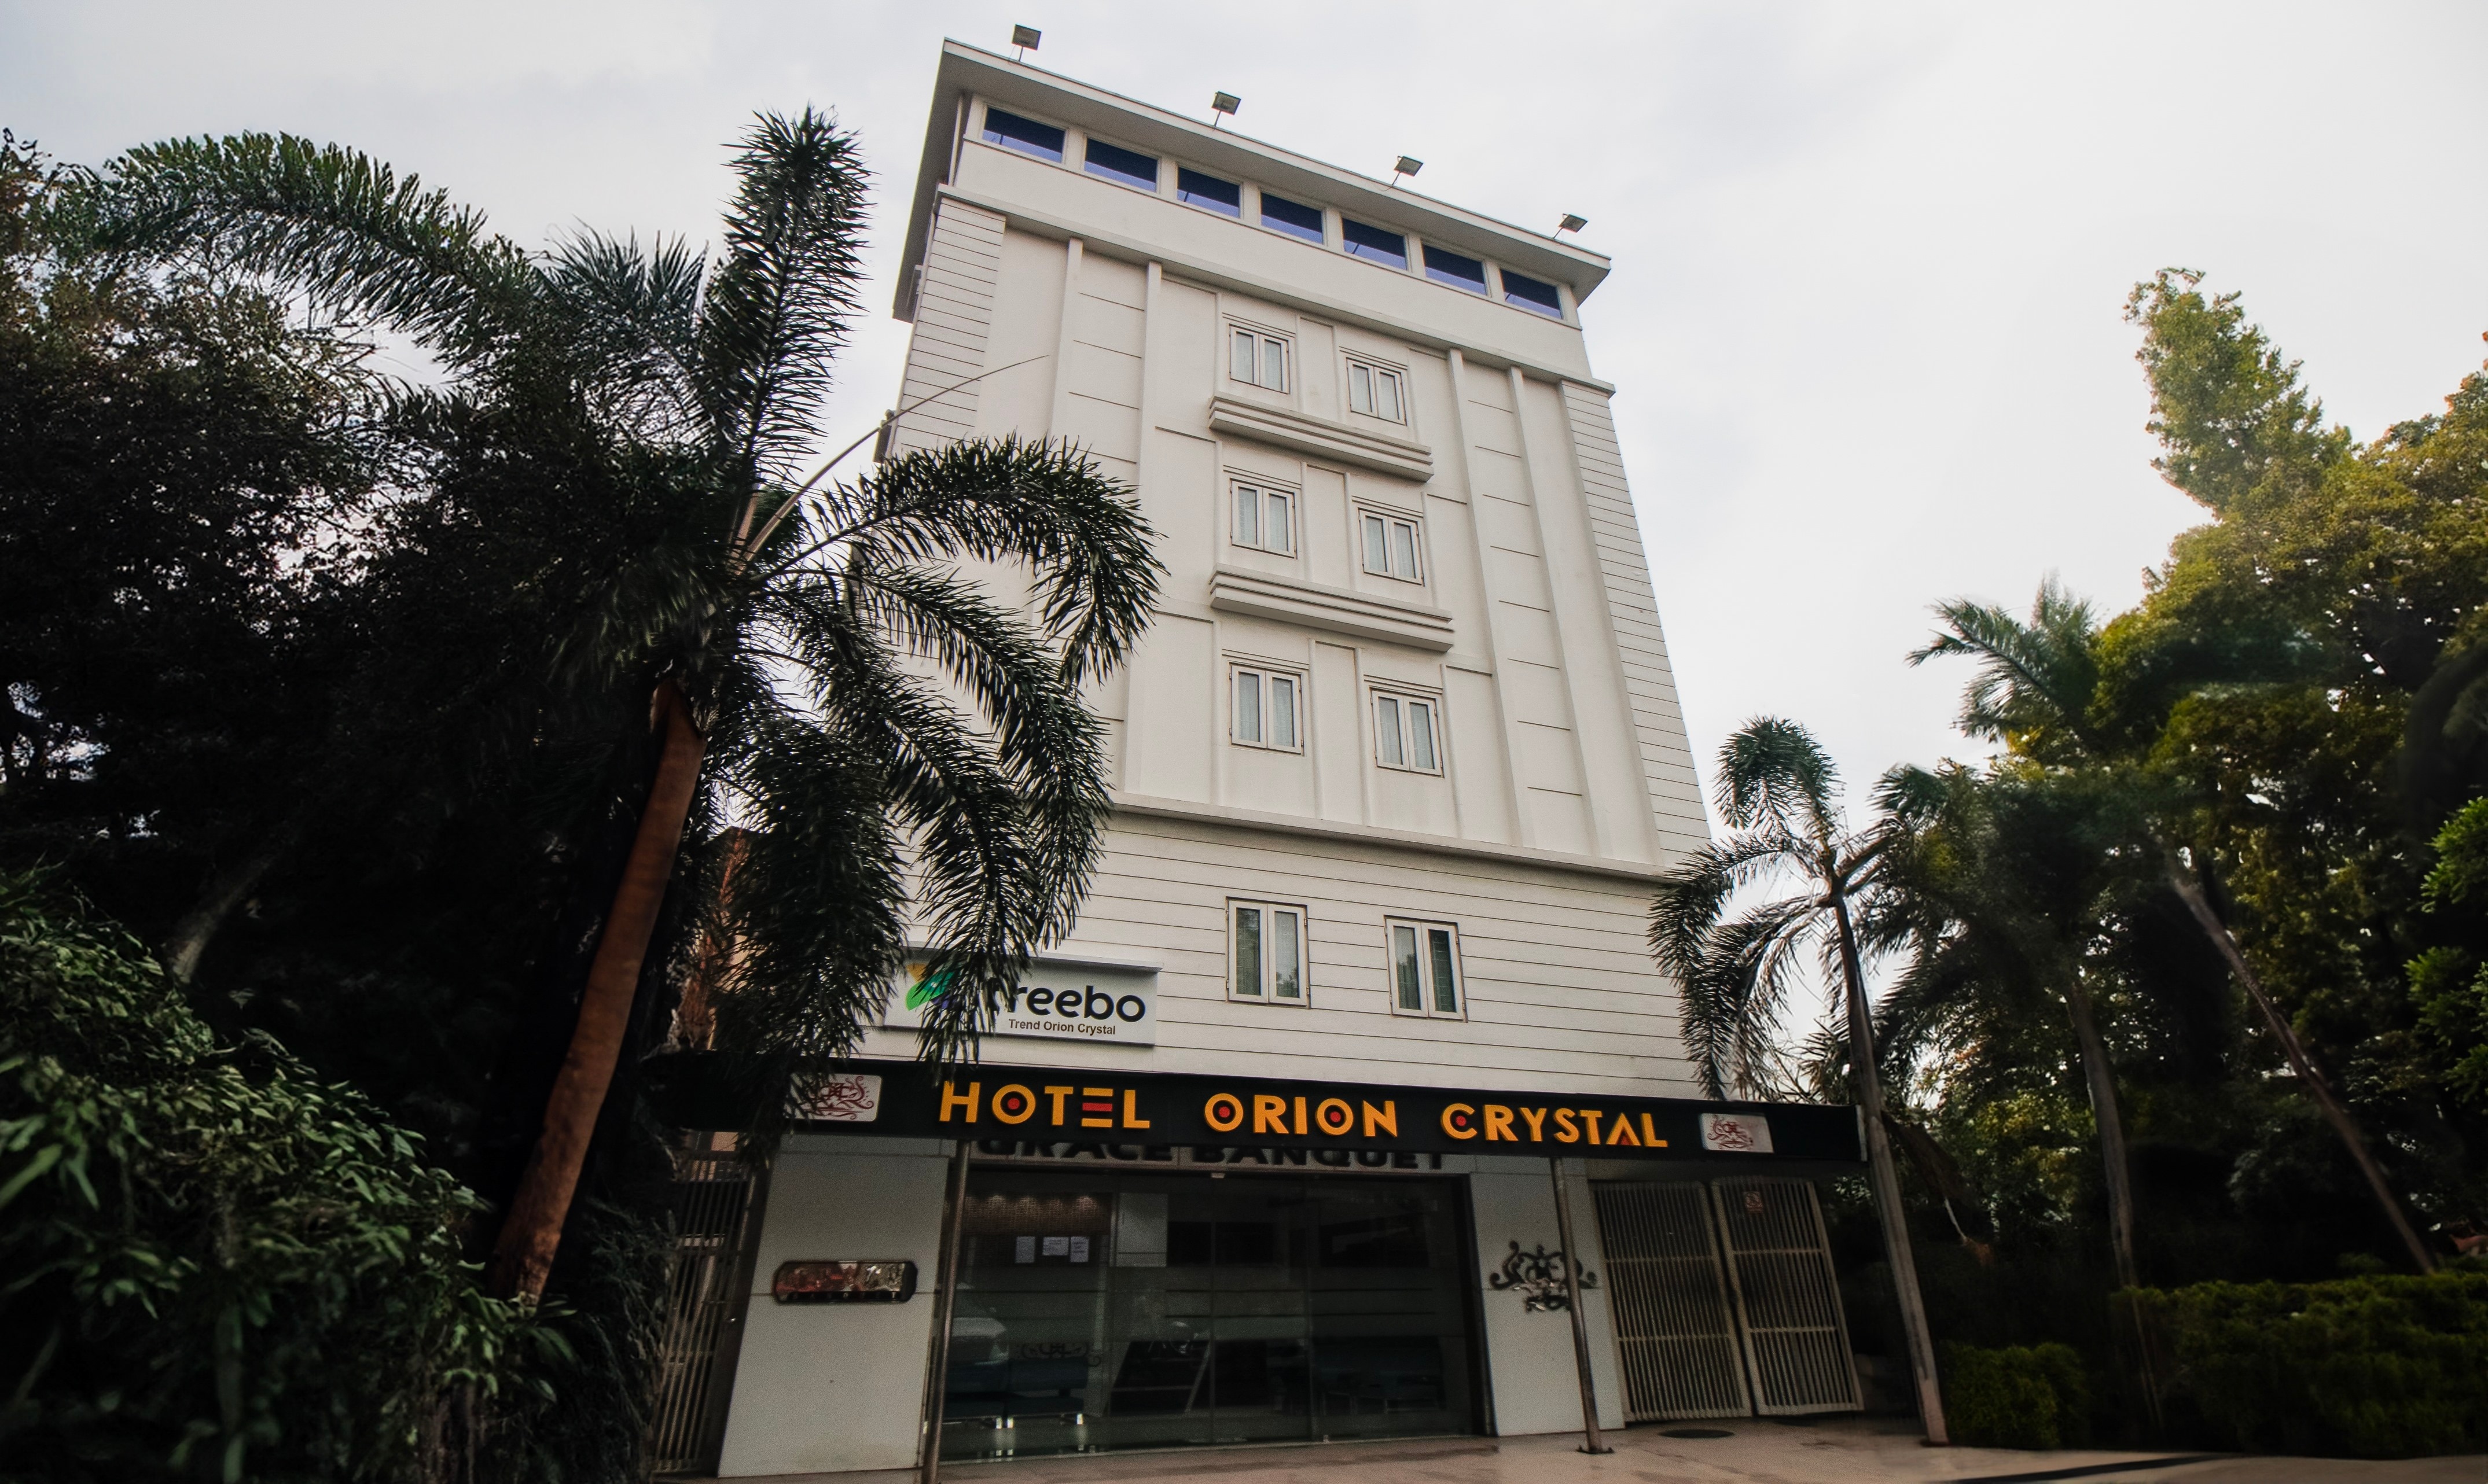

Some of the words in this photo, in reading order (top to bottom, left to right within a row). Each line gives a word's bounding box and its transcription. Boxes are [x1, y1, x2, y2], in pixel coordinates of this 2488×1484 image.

[1008, 1018, 1041, 1030] Trend
[1043, 1021, 1074, 1032] Orion
[1078, 1023, 1116, 1036] Crystal
[939, 1080, 1151, 1129] HOTEL
[1204, 1092, 1398, 1137] ORION
[1440, 1102, 1669, 1148] CRYSTAL
